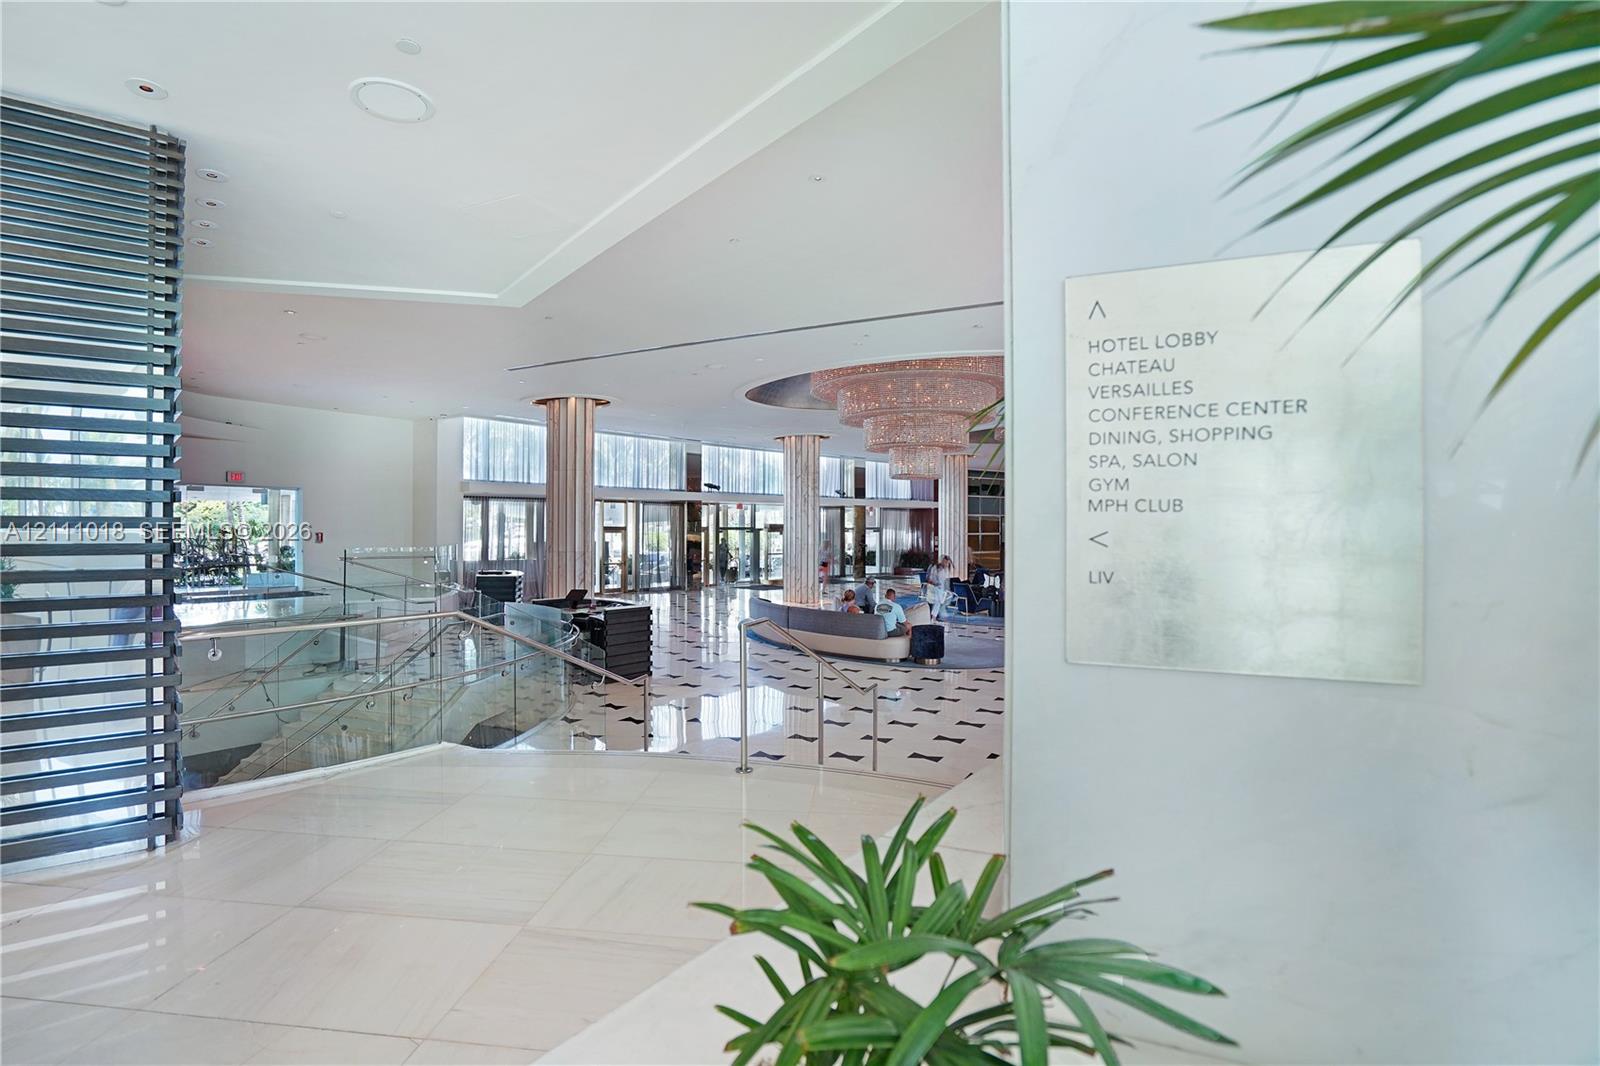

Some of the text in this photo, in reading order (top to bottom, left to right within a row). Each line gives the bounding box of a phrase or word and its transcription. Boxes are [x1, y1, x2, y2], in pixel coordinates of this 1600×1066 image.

[1088, 330, 1219, 354] HOTEL LOBBY
[1088, 358, 1176, 377] CHATEAU
[1088, 380, 1194, 400] VERSAILLES
[1088, 399, 1308, 423] CONFERENCE CENTER
[1088, 425, 1273, 446] DINING, SHOPPING
[1088, 452, 1198, 470] SPA, SALON
[1088, 477, 1130, 492] GYM
[1088, 498, 1184, 513] MPH CLUB
[1088, 570, 1115, 585] LIV
